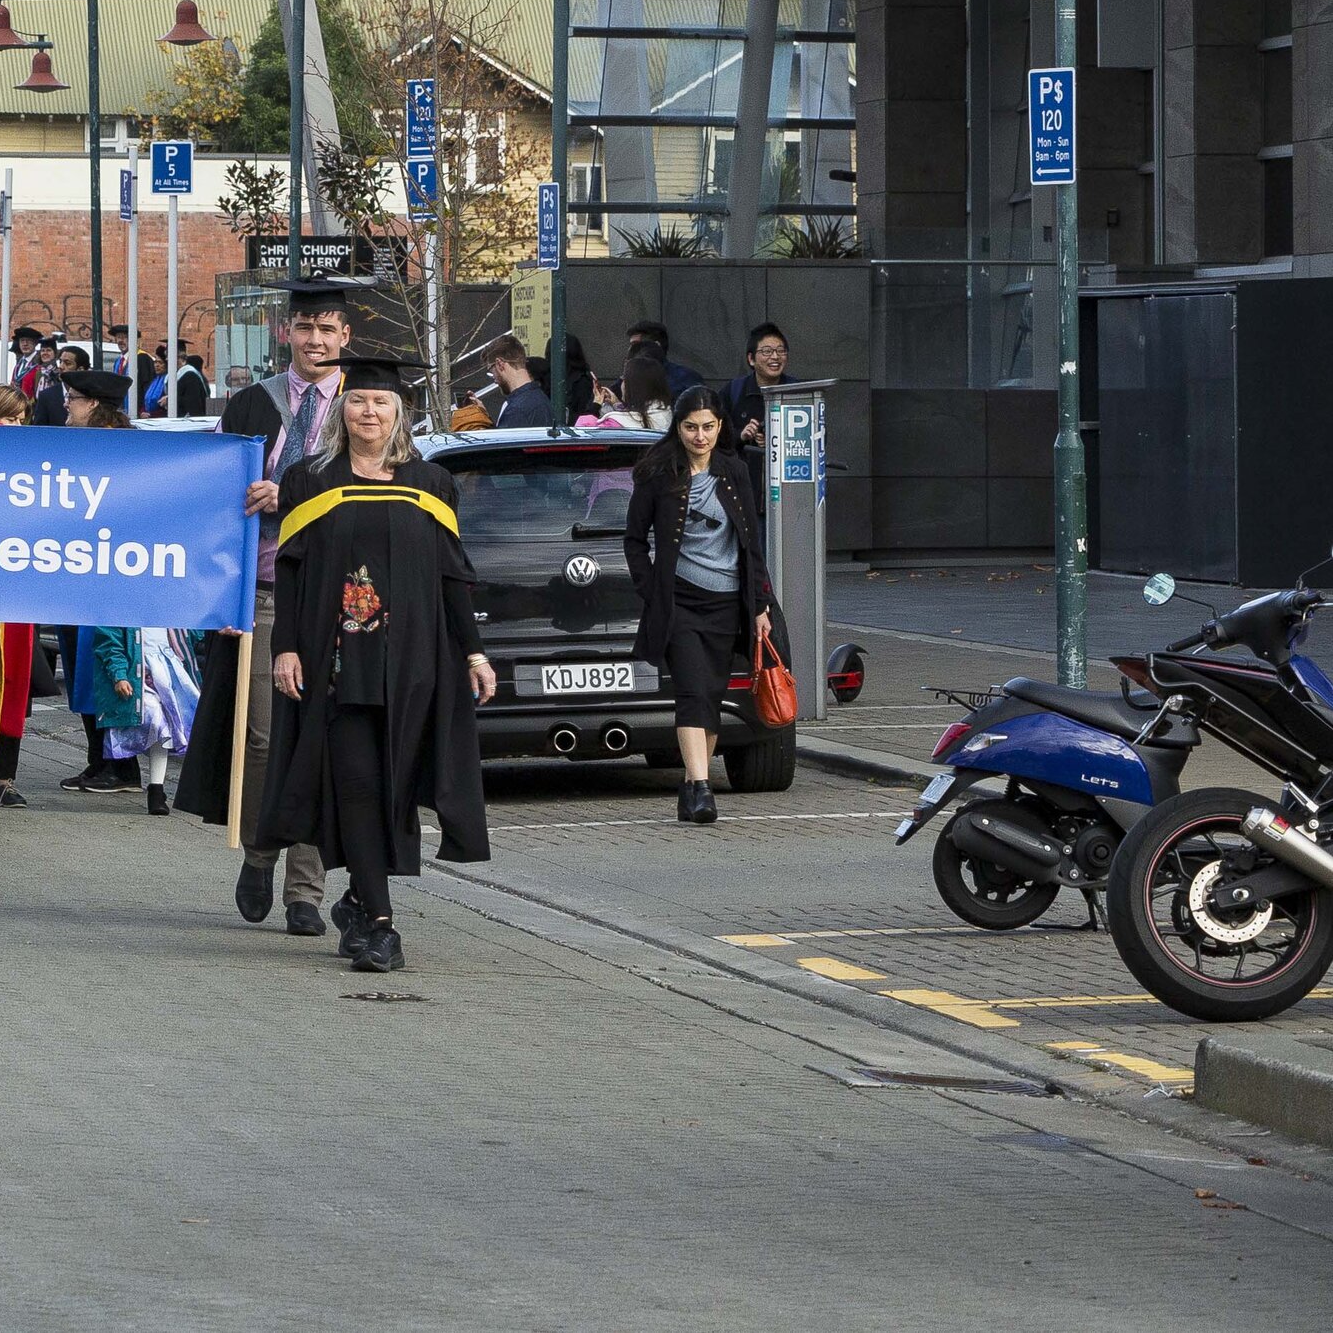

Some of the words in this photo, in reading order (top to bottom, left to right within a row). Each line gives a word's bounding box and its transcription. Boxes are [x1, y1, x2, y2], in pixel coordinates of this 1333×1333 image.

[1041, 109, 1063, 131] 120
[1037, 137, 1052, 147] Mon
[1057, 136, 1070, 146] Sun
[165, 146, 178, 163] P
[1035, 151, 1050, 161] 9am
[1055, 150, 1070, 163] 6pm
[168, 163, 175, 177] 5
[418, 164, 428, 183] P
[543, 213, 554, 230] 120
[259, 257, 282, 268] ART
[787, 409, 810, 438] P
[771, 435, 778, 448] C
[789, 440, 806, 448] PAY
[771, 450, 778, 463] 3
[785, 448, 811, 457] HERE
[545, 667, 631, 690] KDJ892
